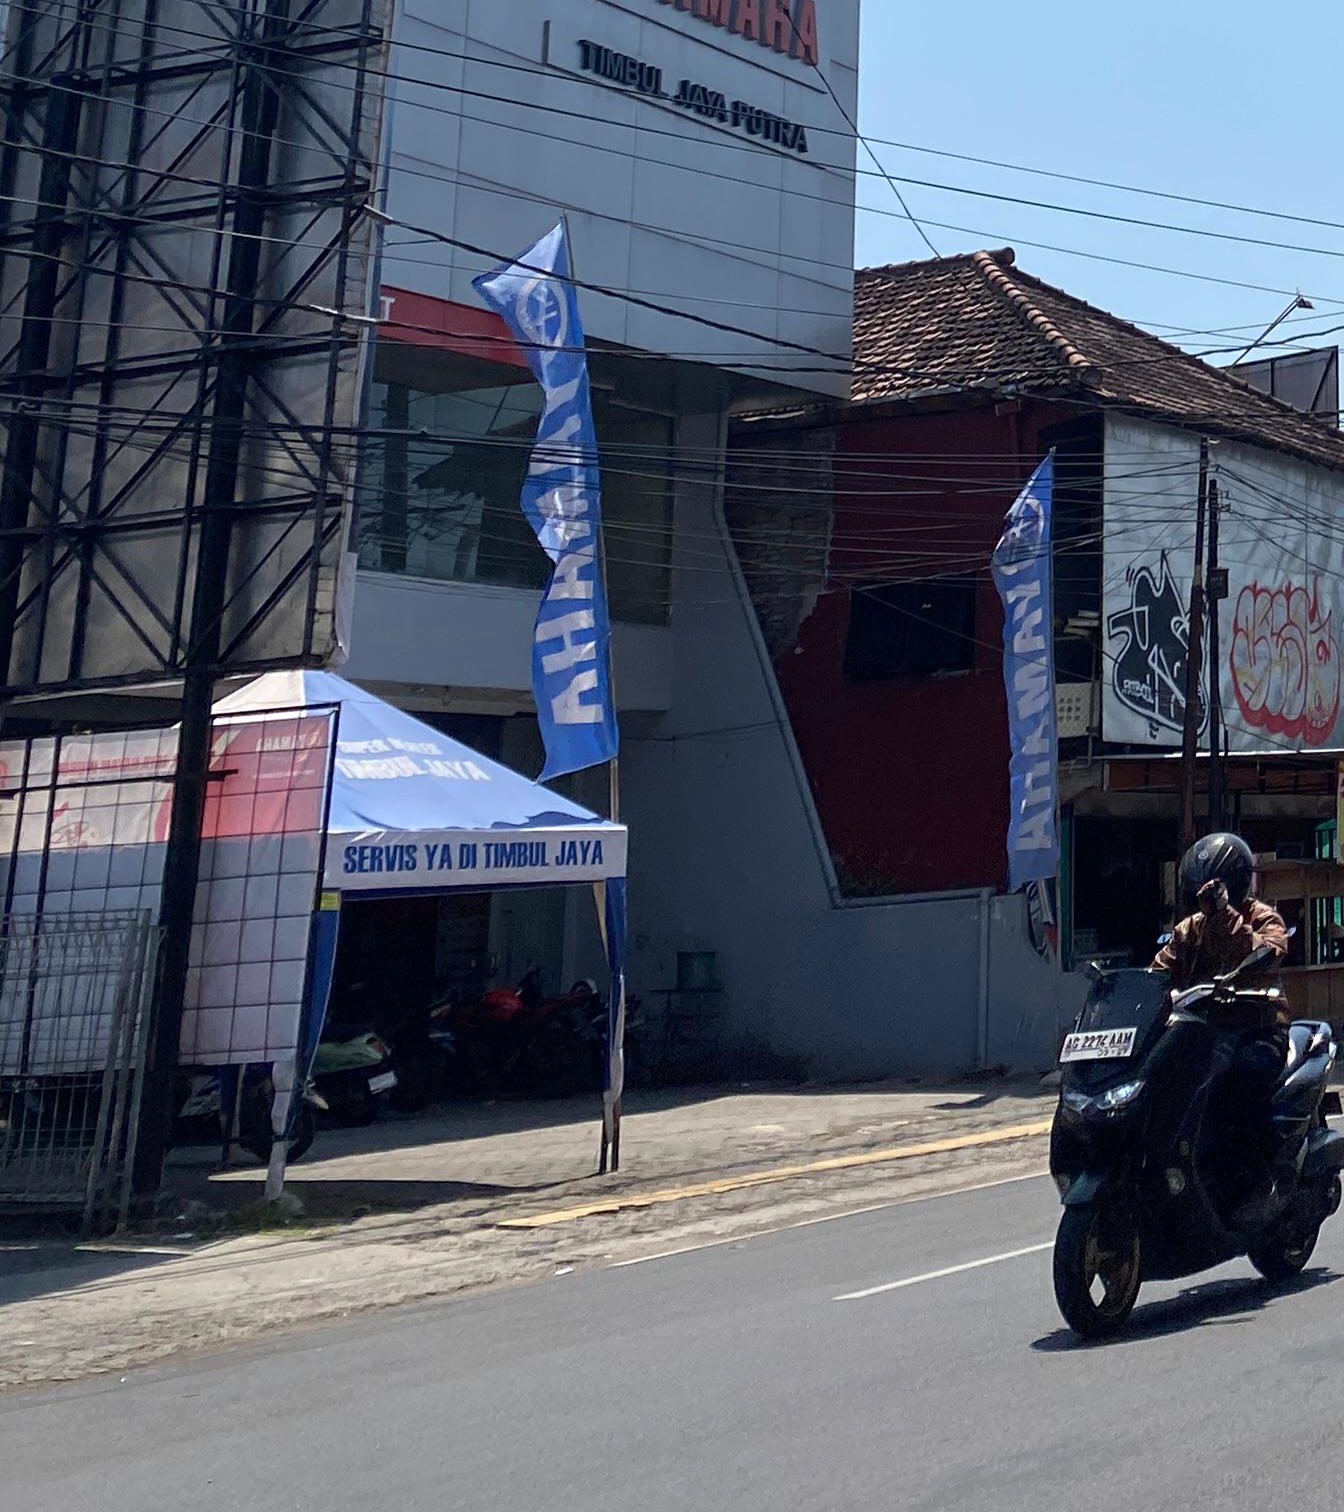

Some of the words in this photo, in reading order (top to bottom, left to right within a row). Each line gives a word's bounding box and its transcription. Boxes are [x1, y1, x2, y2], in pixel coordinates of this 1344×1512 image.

[577, 38, 670, 98] TIMBUL
[672, 78, 729, 124] JAYA
[730, 99, 809, 153] PUTRA
[335, 755, 428, 780] TIMBUL
[423, 759, 491, 781] JAYA
[343, 844, 417, 874] SERVIS
[425, 842, 452, 870] YA
[458, 842, 478, 869] DI
[482, 840, 549, 868] TIMBUL
[554, 839, 604, 866] JAYA
[1066, 1037, 1081, 1049] AG
[1108, 1031, 1134, 1046] AAM
